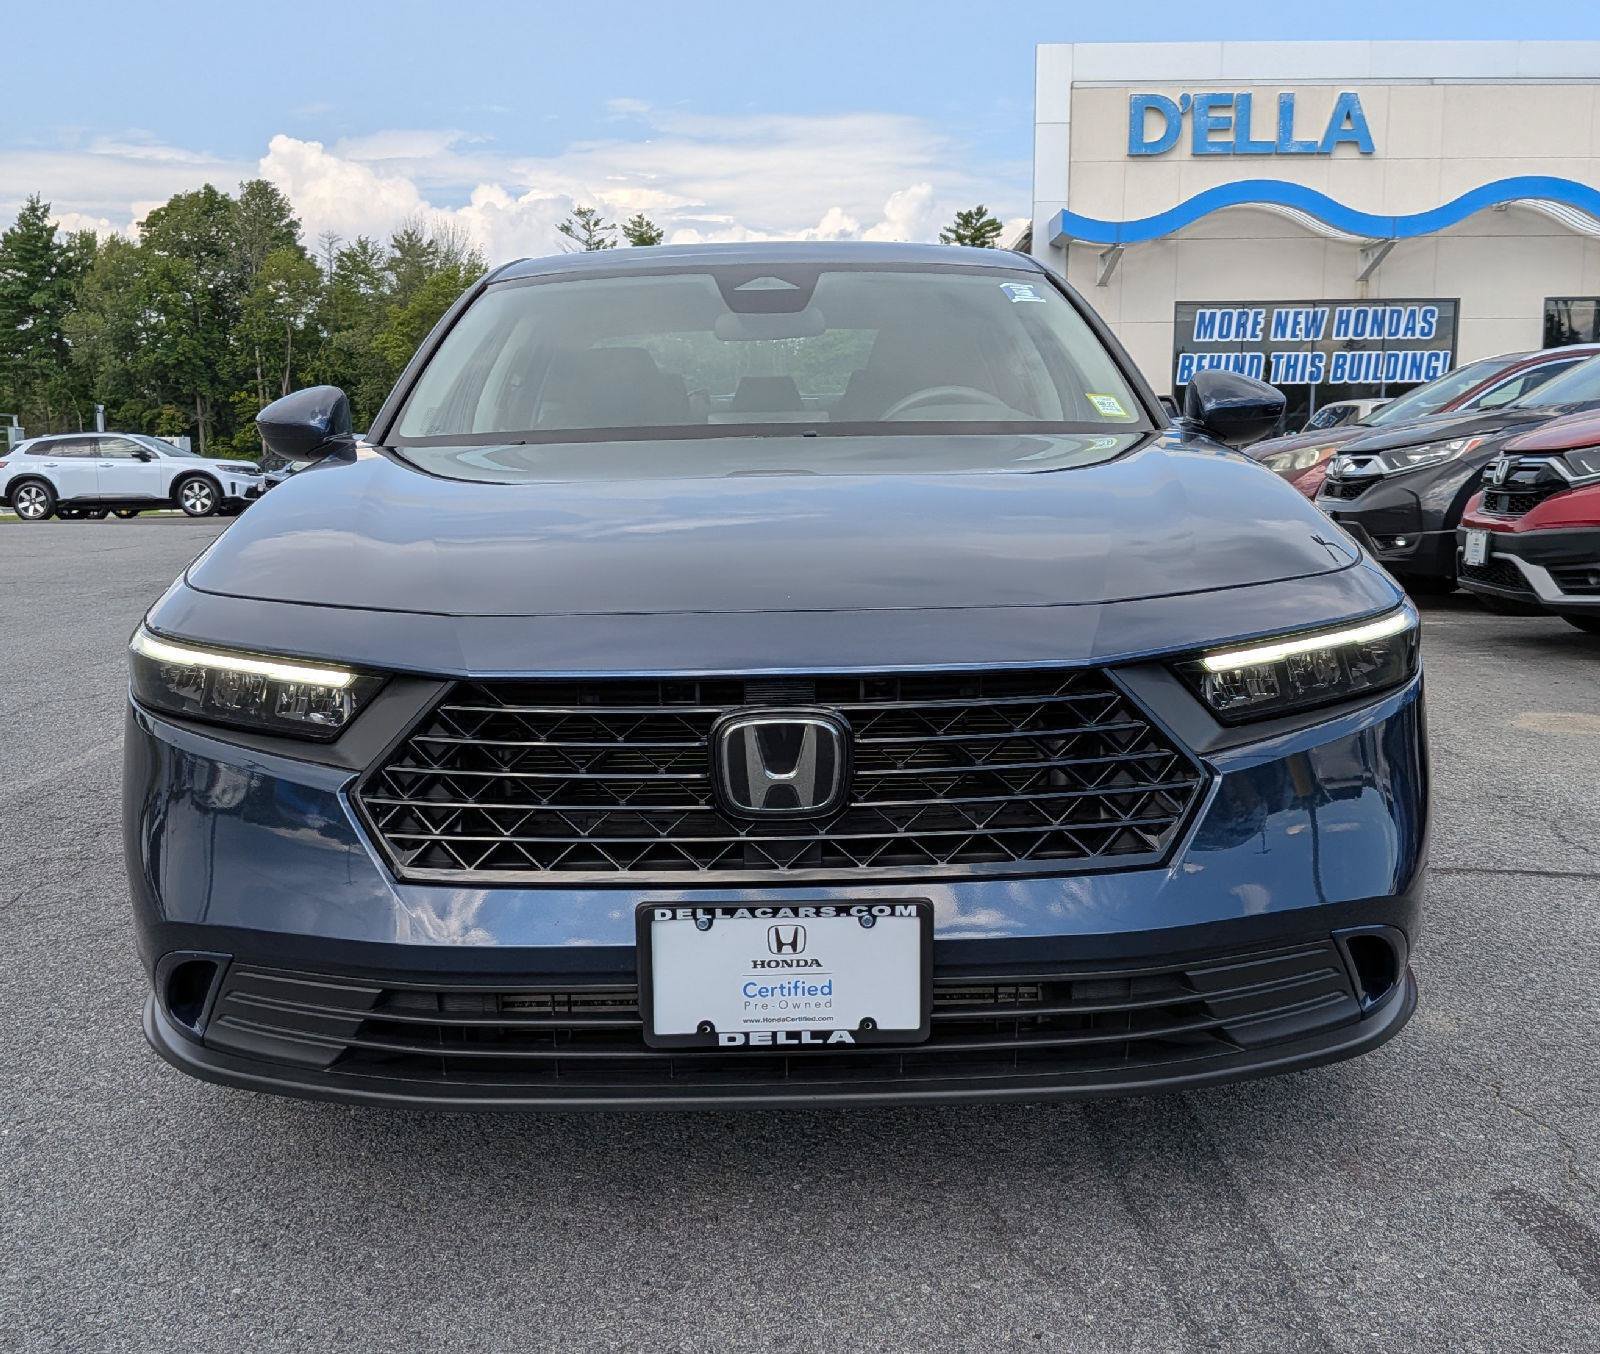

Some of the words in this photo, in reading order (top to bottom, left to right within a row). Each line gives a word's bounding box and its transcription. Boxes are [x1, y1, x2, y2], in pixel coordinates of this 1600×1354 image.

[1127, 92, 1376, 157] D'ELLA
[1194, 309, 1263, 341] MORE
[1271, 308, 1327, 341] NEW
[1333, 306, 1438, 340] HONDAS
[1270, 352, 1325, 384] THIS
[1330, 351, 1451, 383] BUILDING!
[654, 905, 917, 921] DELLACARS.COM
[751, 958, 823, 969] HONDA
[743, 979, 832, 998] Certified
[744, 999, 832, 1011] Pre-Owned
[743, 1016, 834, 1024] www.HondaCertified.com
[718, 1031, 855, 1046] DELLA
